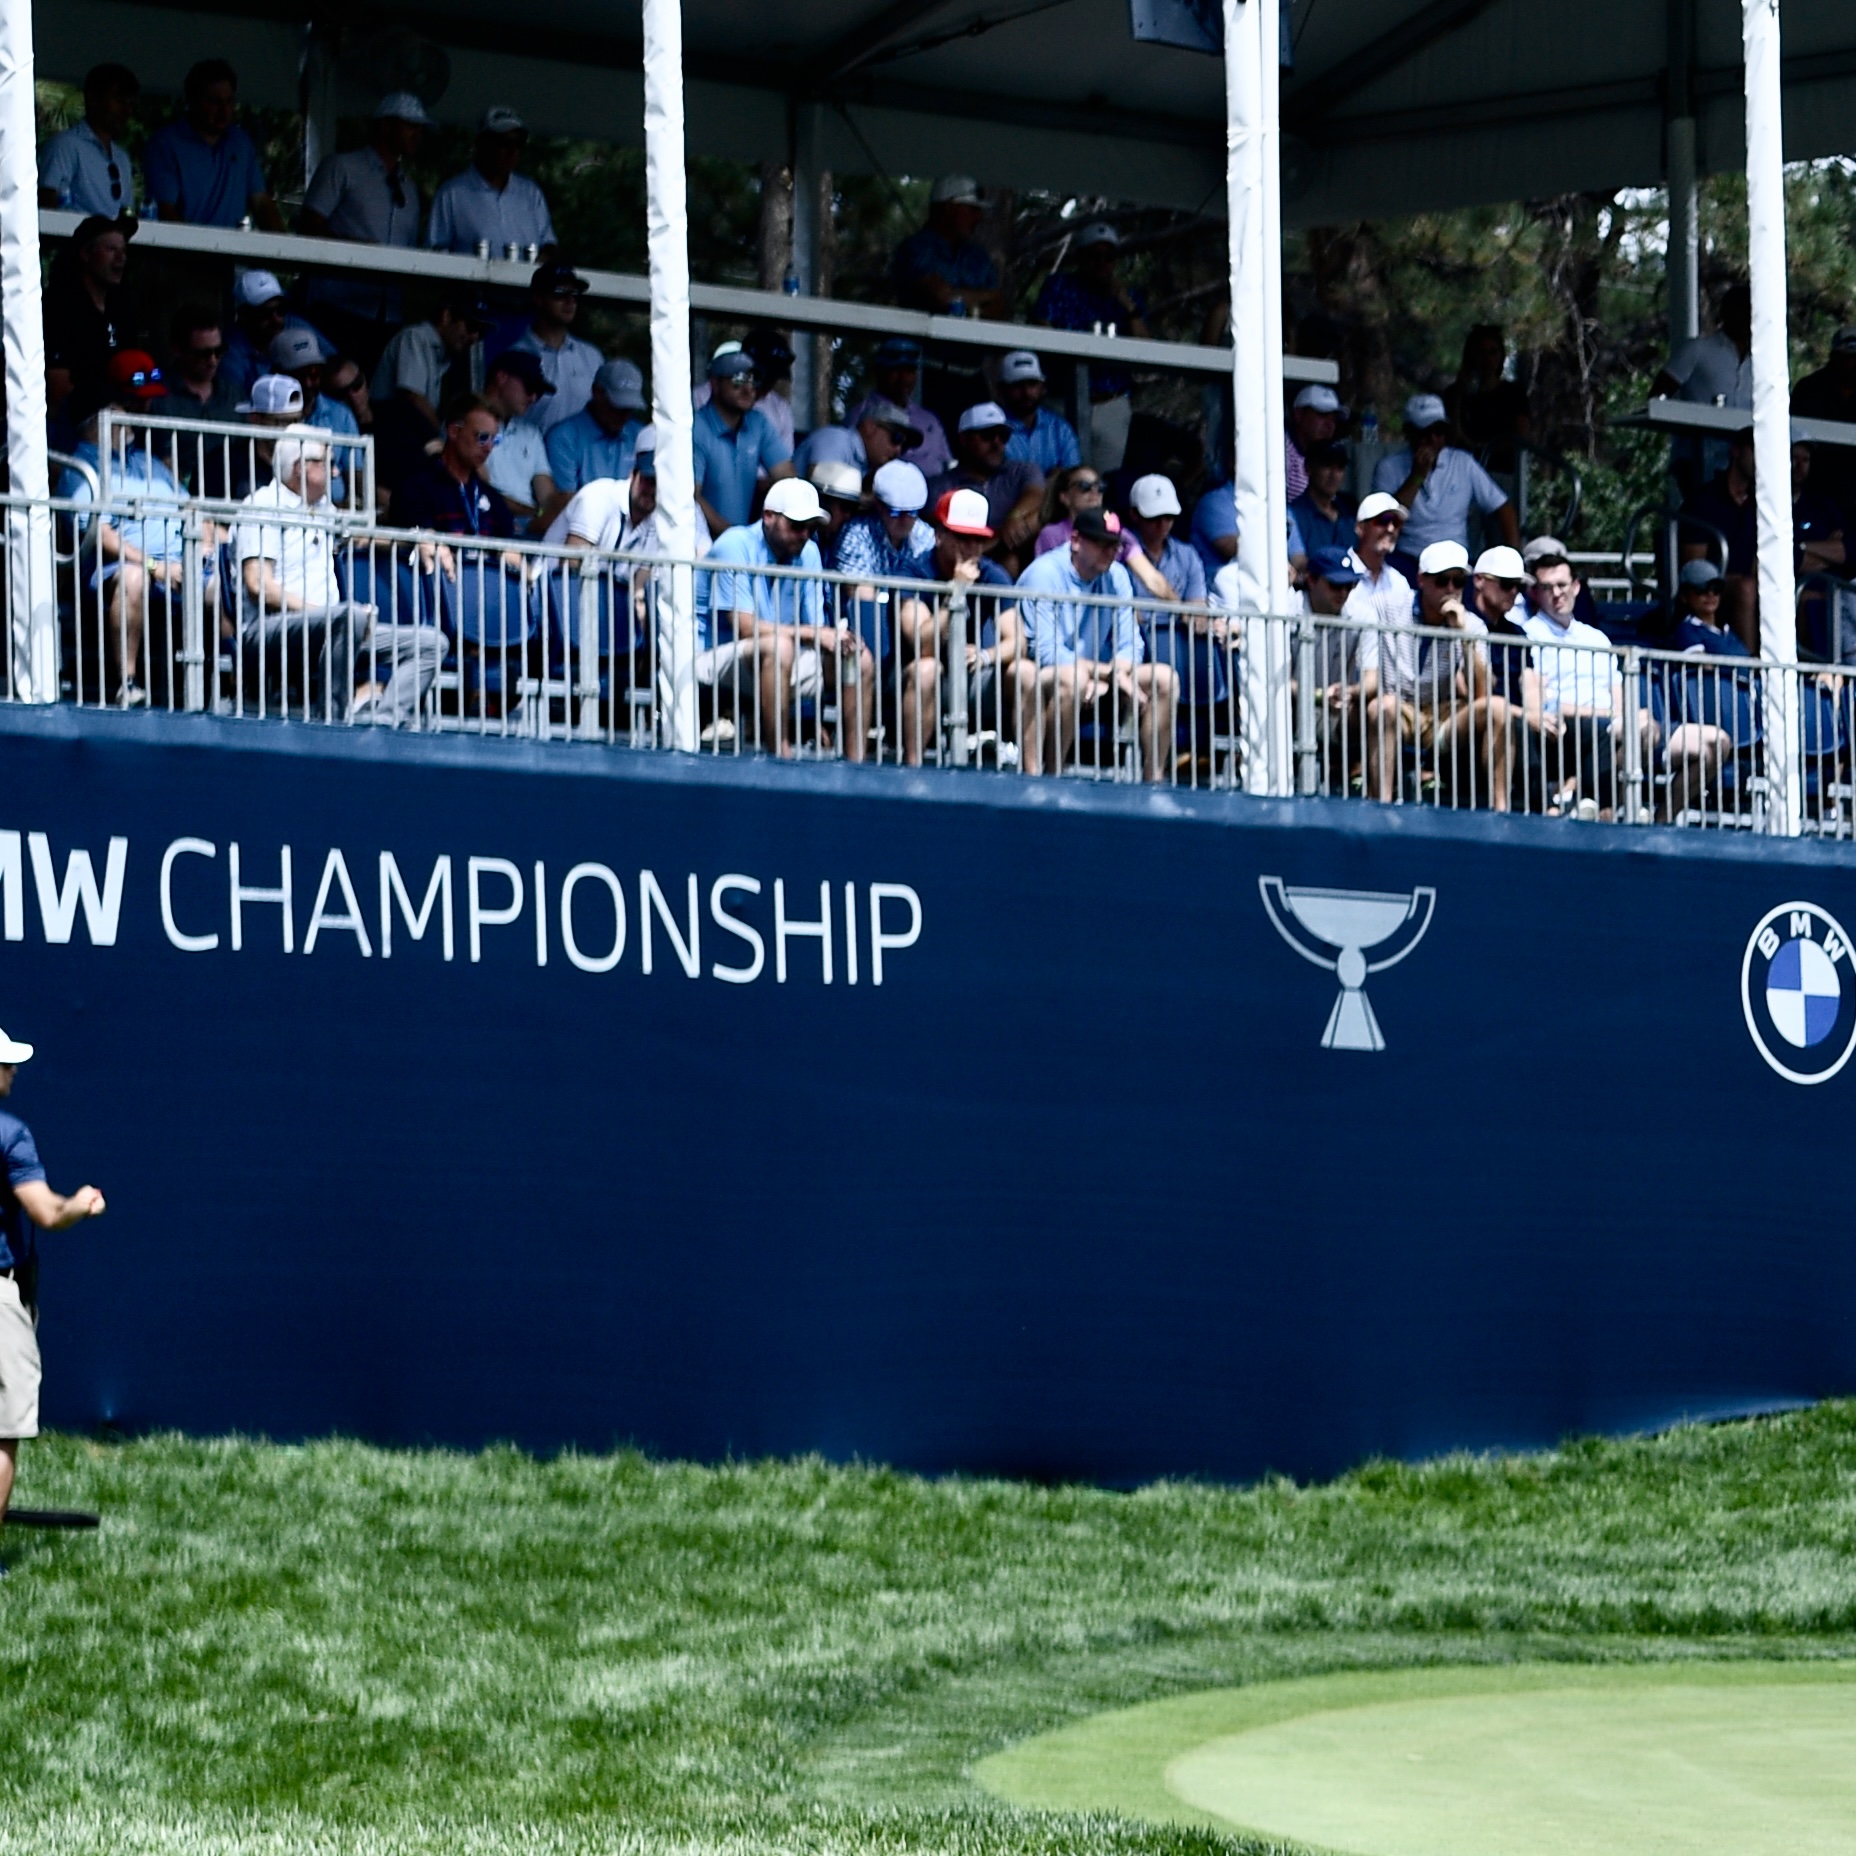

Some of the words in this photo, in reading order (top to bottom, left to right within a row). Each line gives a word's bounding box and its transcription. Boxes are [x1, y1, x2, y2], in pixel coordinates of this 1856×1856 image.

[0, 829, 129, 946] W
[160, 838, 922, 987] CHAMPIONSHIP
[1757, 911, 1847, 961] BMW
